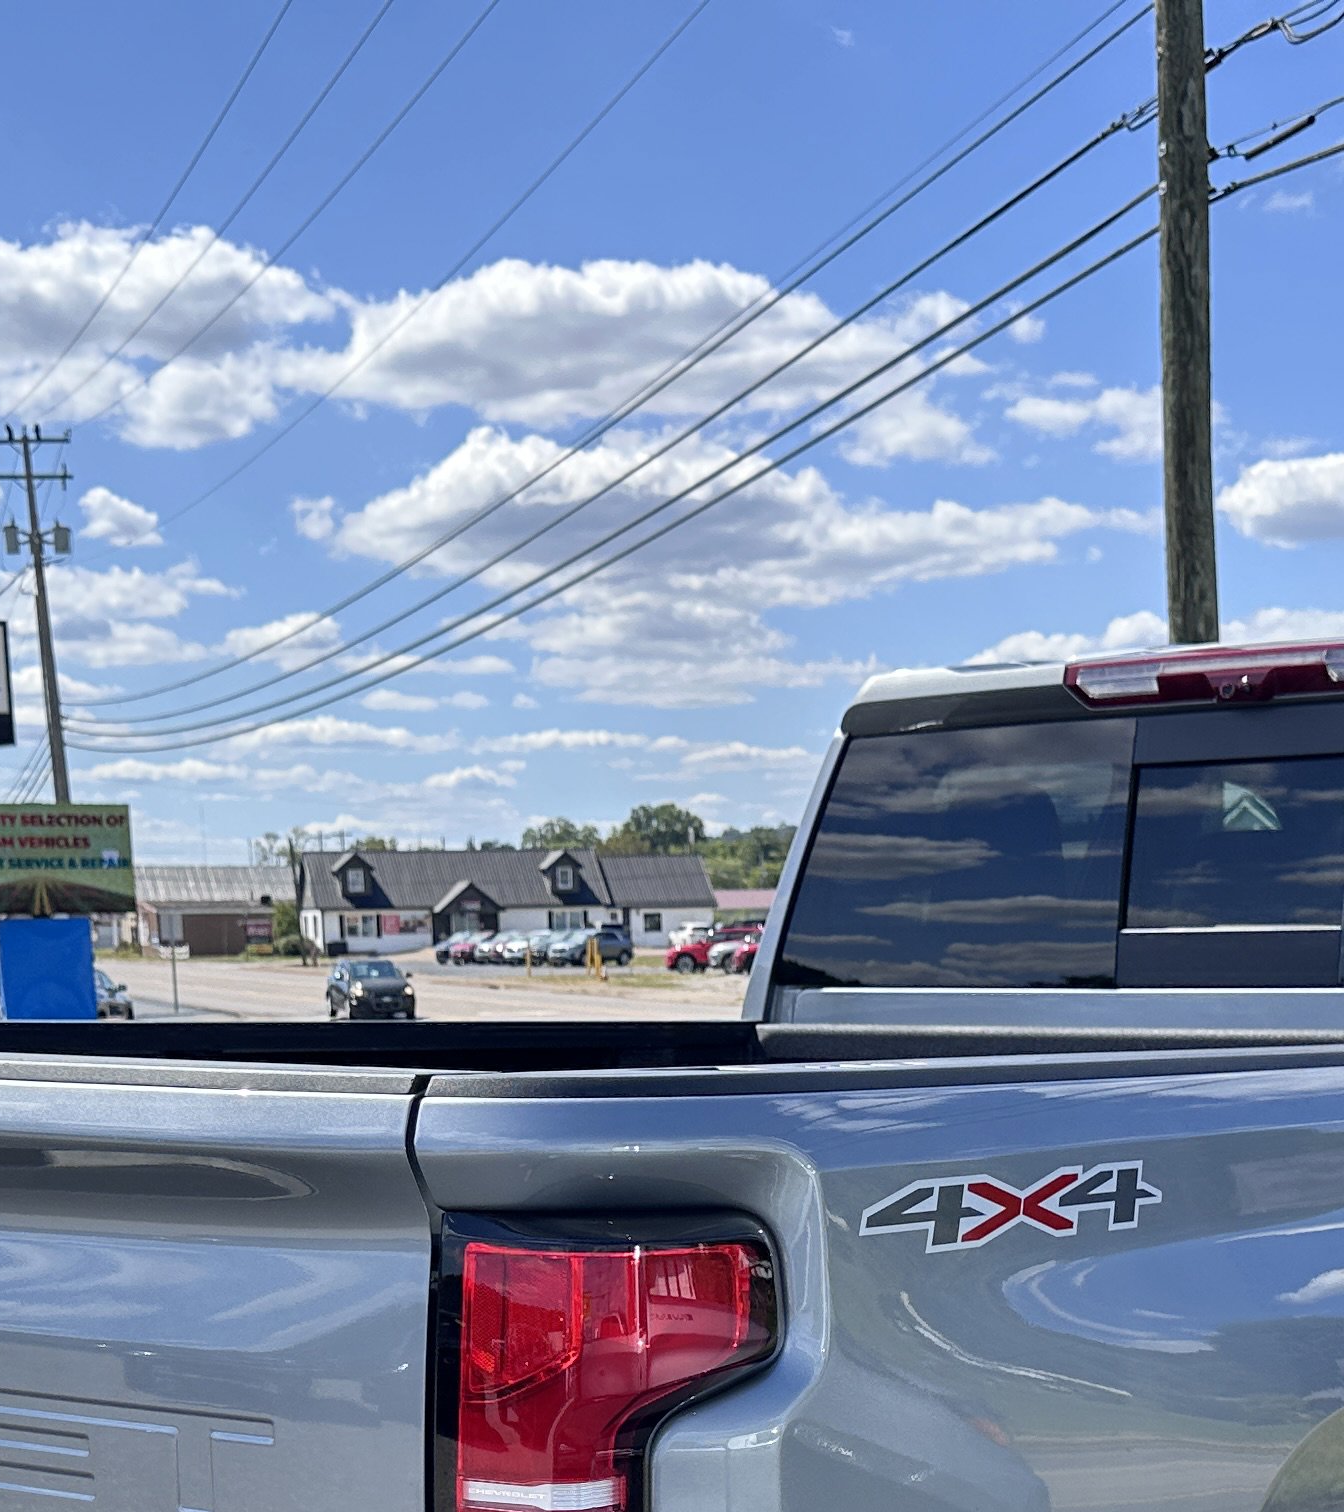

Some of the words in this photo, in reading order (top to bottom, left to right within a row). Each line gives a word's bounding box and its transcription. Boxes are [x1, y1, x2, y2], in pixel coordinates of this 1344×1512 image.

[21, 814, 102, 827] SELECTION
[106, 814, 126, 827] OF
[17, 836, 91, 849] VEHICLES
[8, 857, 64, 870] SERVICE
[68, 857, 78, 869] &
[81, 857, 129, 869] REPAIR
[468, 1487, 547, 1500] CHEVROLET
